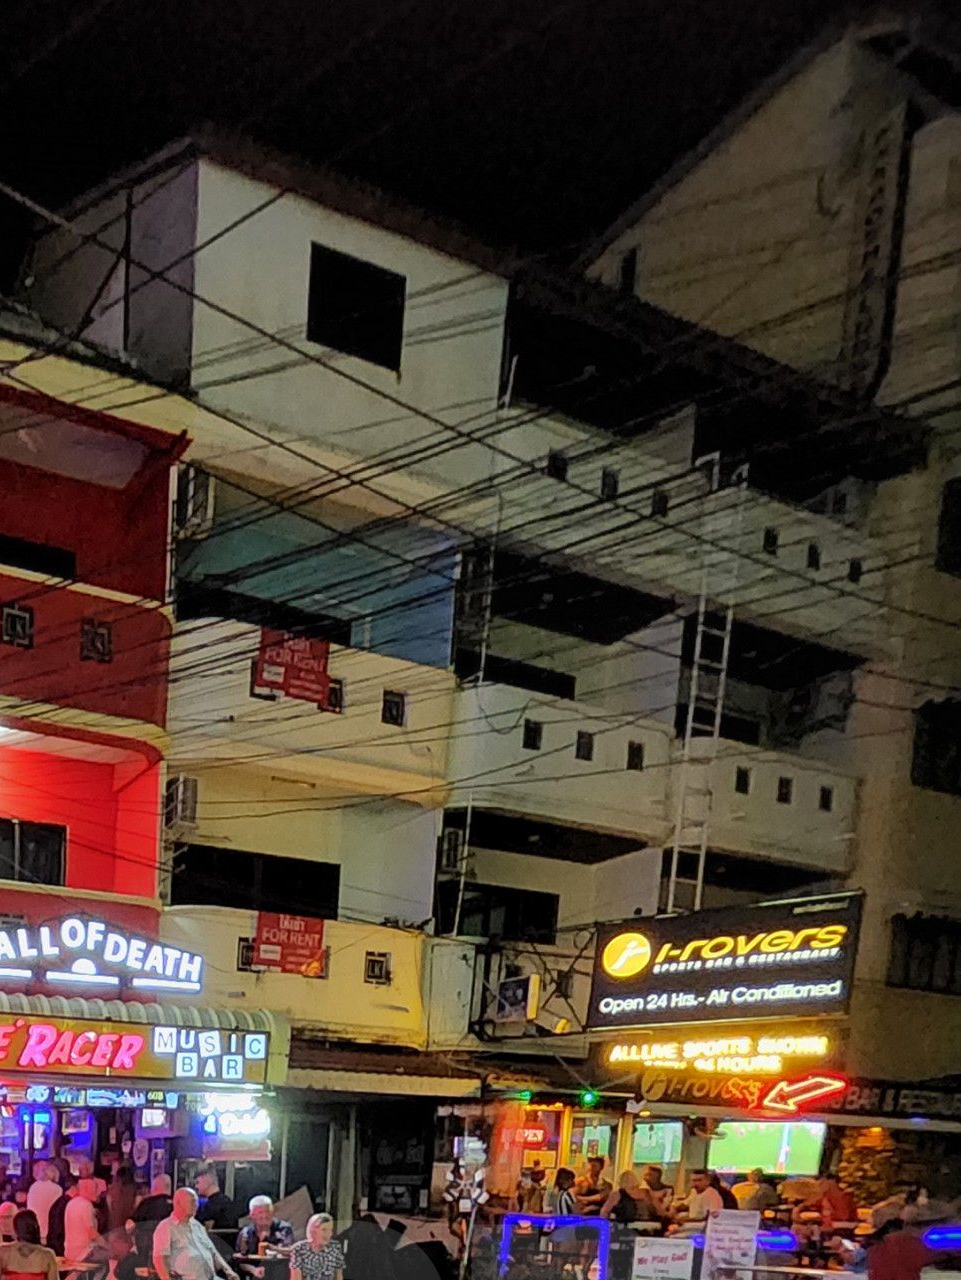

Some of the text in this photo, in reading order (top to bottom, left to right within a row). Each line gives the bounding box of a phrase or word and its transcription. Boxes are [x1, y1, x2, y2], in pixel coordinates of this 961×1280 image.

[60, 917, 106, 952] OF
[103, 933, 204, 982] DEATH
[262, 927, 321, 948] FOR RENT
[598, 996, 644, 1015] Open
[645, 993, 668, 1010] 24
[706, 988, 730, 1006] Air
[731, 980, 843, 1004] Conditioned
[18, 1023, 144, 1069] RACER
[153, 1025, 266, 1059] MUSIC
[683, 1036, 753, 1058] SPORTS
[176, 1054, 243, 1078] BAR
[515, 1128, 545, 1142] OPEN
